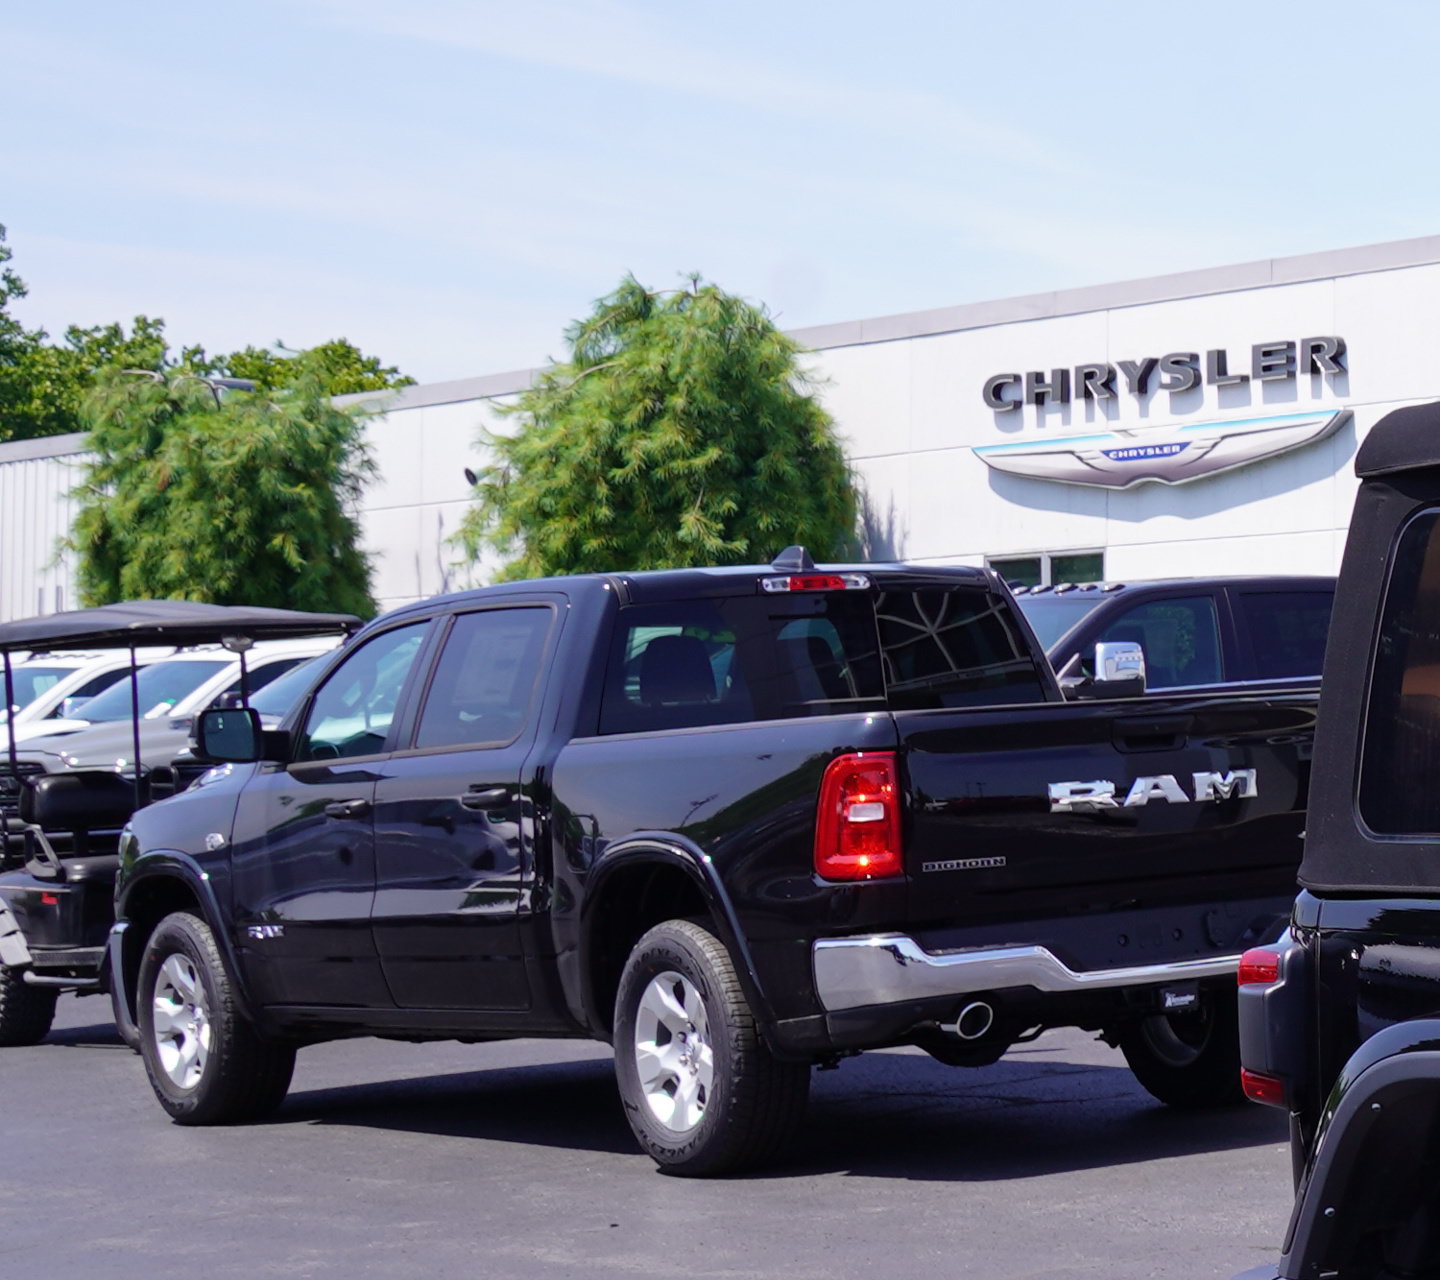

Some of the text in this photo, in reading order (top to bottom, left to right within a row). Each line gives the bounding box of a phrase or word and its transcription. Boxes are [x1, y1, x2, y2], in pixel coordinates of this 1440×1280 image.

[983, 335, 1347, 412] CHRYSLER
[1108, 444, 1181, 460] CHRYSLER
[1048, 767, 1258, 813] RAM
